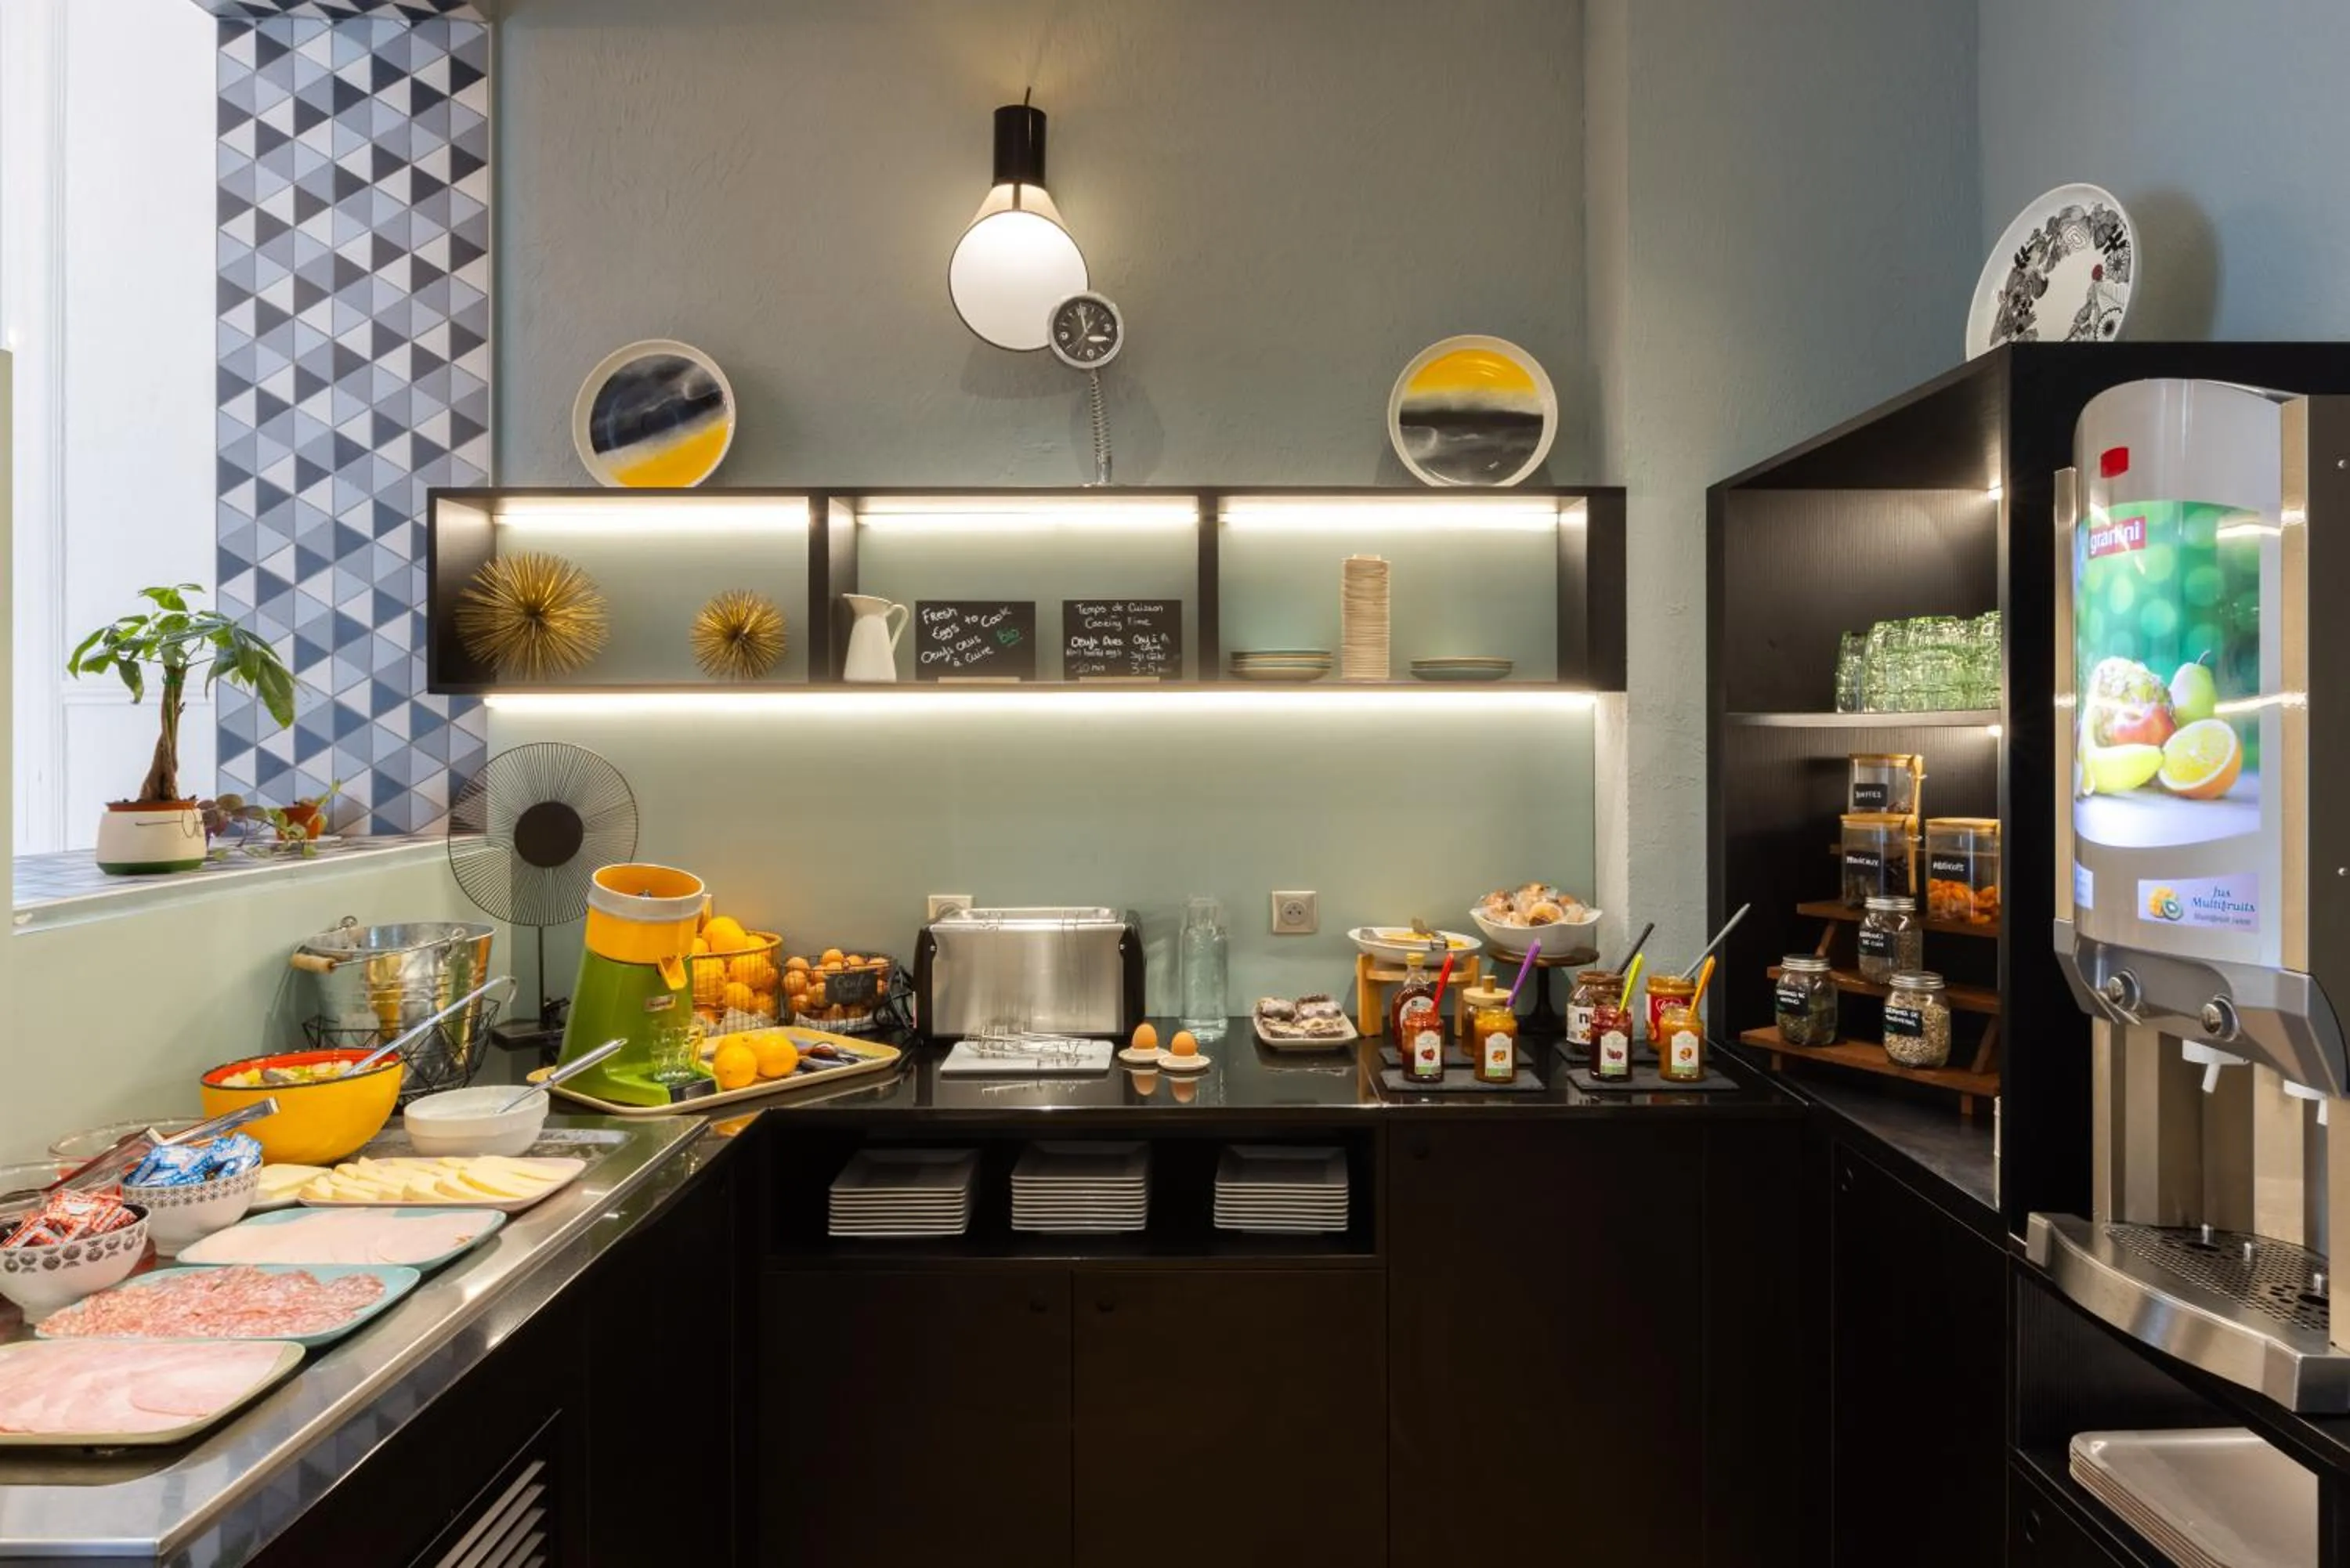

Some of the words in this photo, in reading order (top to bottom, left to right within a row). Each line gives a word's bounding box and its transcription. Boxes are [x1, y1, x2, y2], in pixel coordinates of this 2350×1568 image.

[1112, 602, 1123, 612] de
[981, 606, 1013, 627] Cook
[1085, 617, 1123, 631] Cooking
[931, 623, 960, 641] Eggs
[2212, 885, 2232, 898] Jus
[2191, 897, 2256, 912] Multifruits
